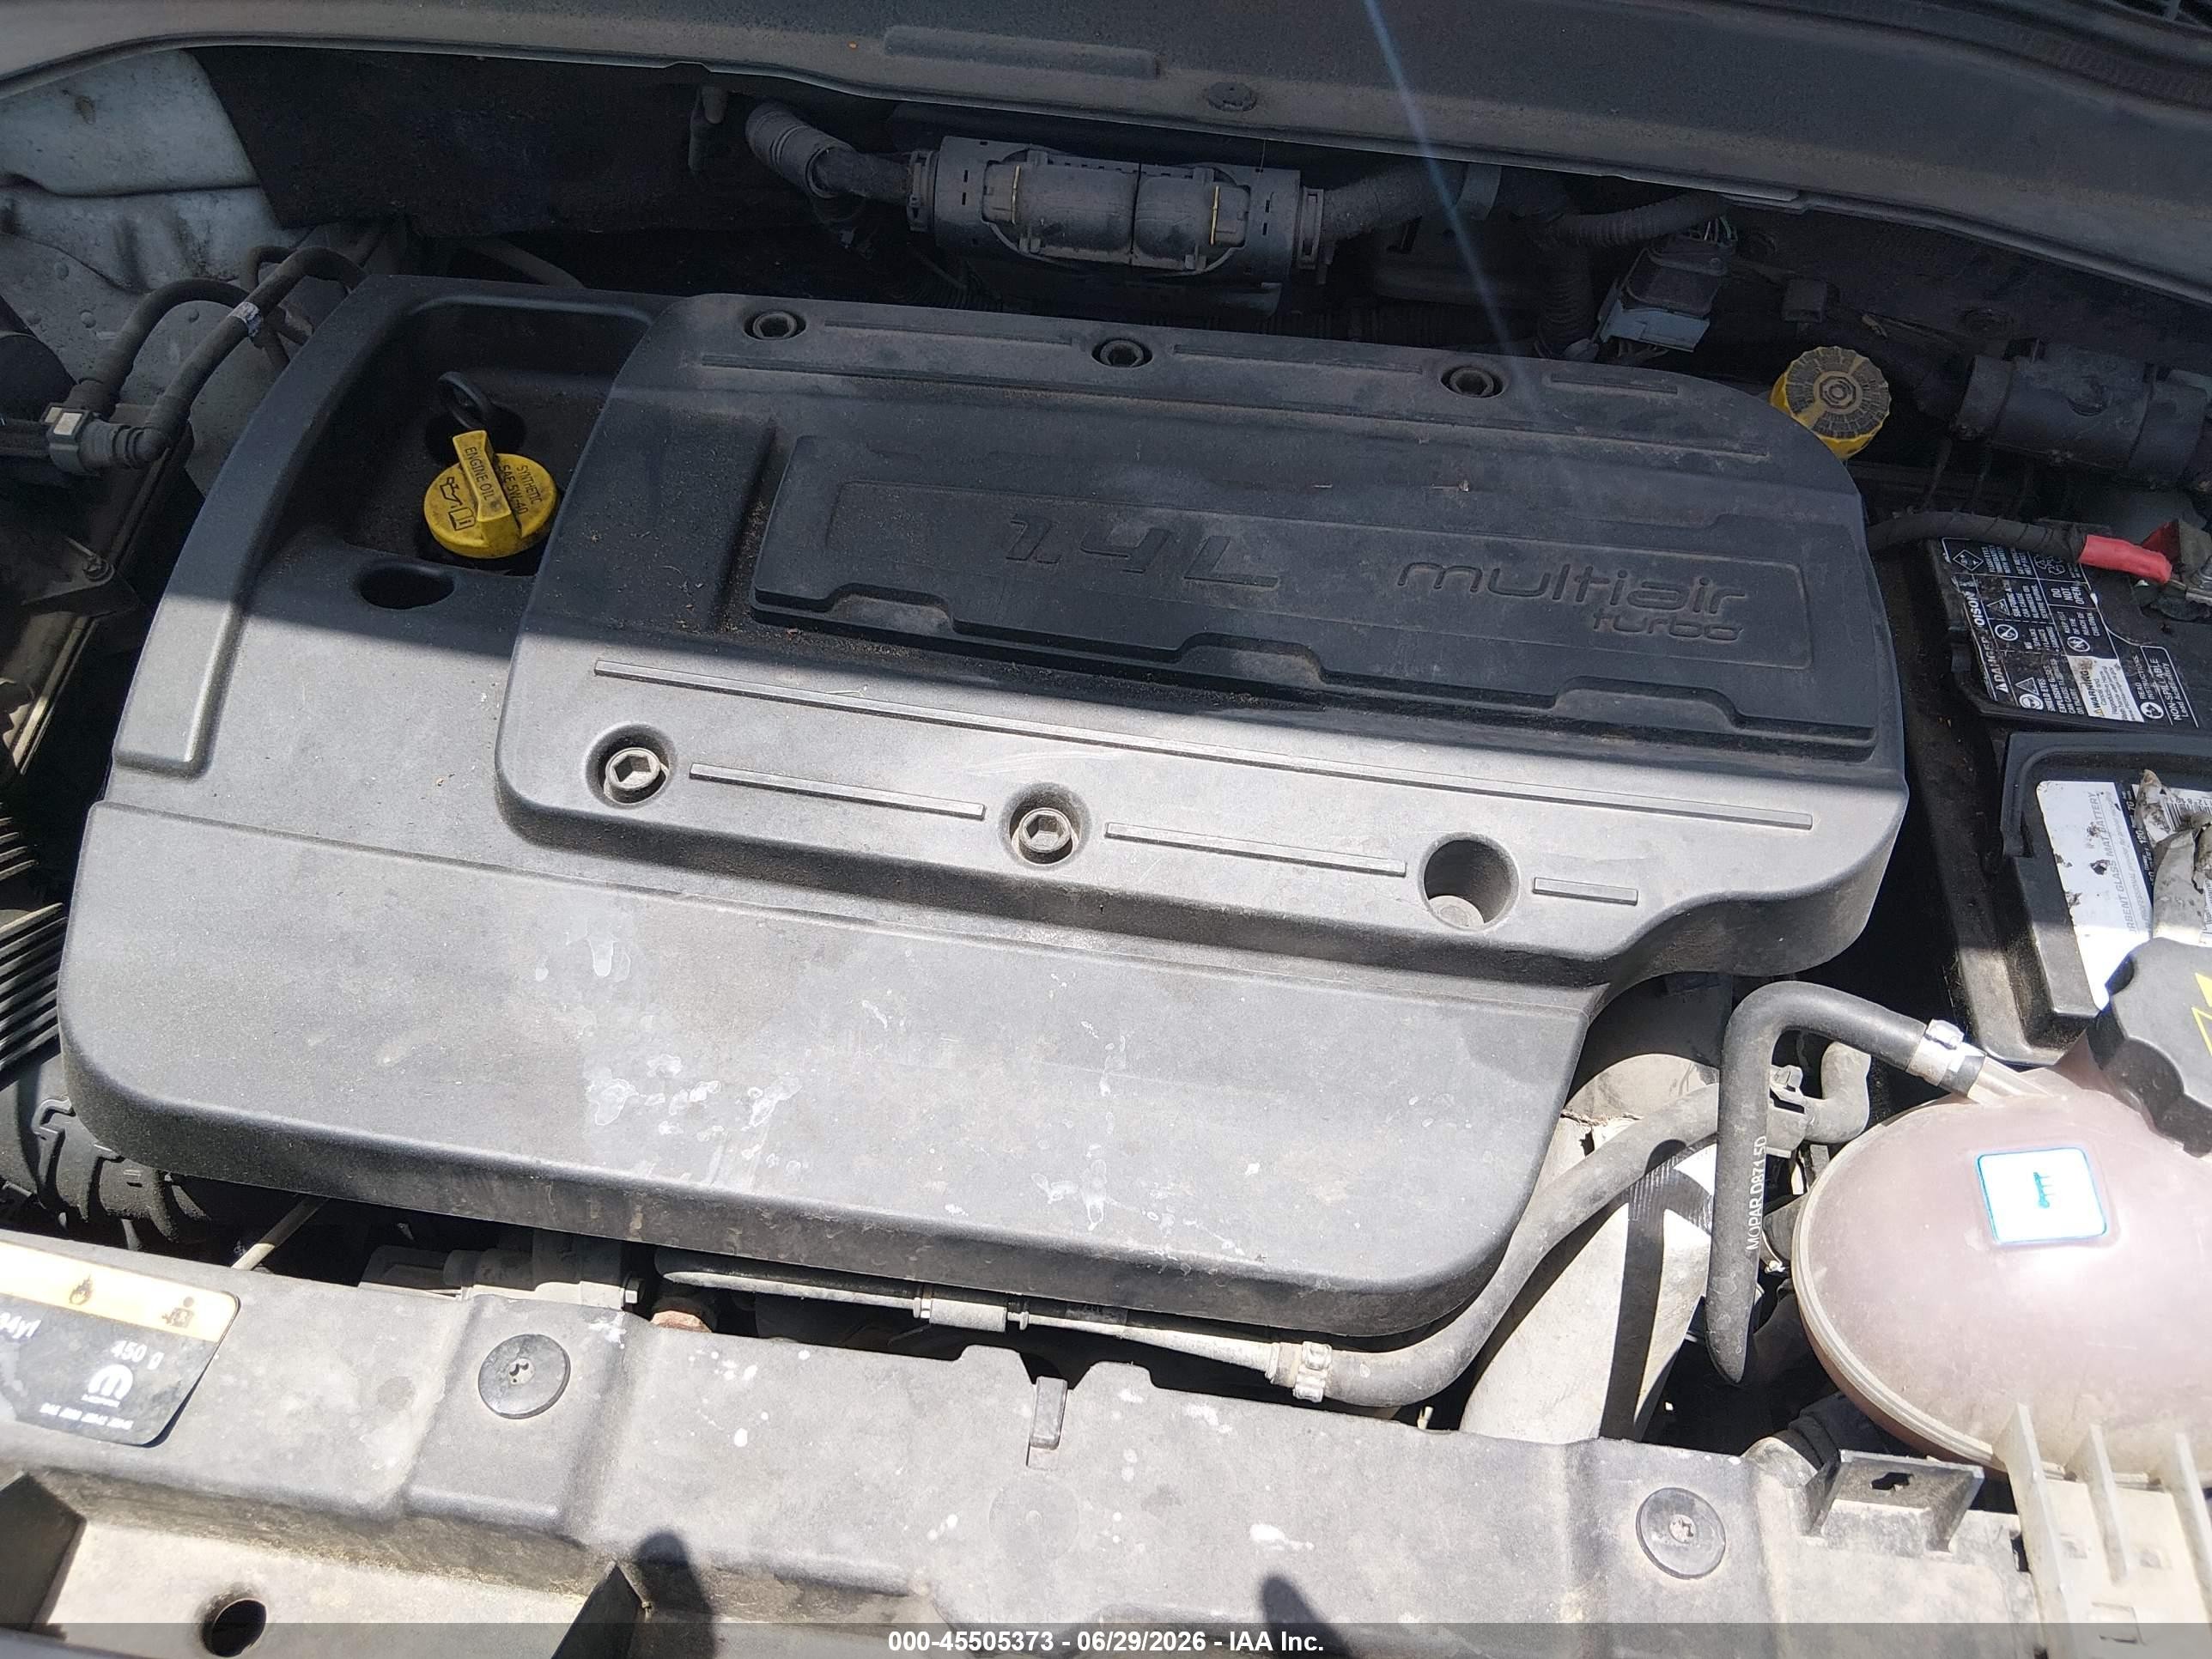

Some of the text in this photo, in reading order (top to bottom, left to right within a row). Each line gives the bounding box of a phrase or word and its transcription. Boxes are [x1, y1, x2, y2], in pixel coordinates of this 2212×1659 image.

[465, 447, 495, 501] ENGINE OIL
[516, 465, 543, 505] SYNTHETIC
[499, 465, 529, 515] SAE 5W-40
[1397, 562, 1746, 615] multiair
[2050, 587, 2062, 598] DO
[2060, 586, 2074, 600] NOT
[2069, 586, 2085, 604] OPEN
[2015, 592, 2030, 617] CAN CAUSE
[1593, 609, 1743, 641] turbo
[2134, 681, 2147, 699] READ
[2149, 658, 2182, 720] NON-SPILLABLE
[2065, 702, 2075, 714] CAN
[2176, 701, 2189, 717] Lead
[2088, 792, 2136, 933] RBENT GLASS MAT BATTERY
[1746, 1199, 1762, 1251] MOPAR
[110, 1340, 148, 1362] 450
